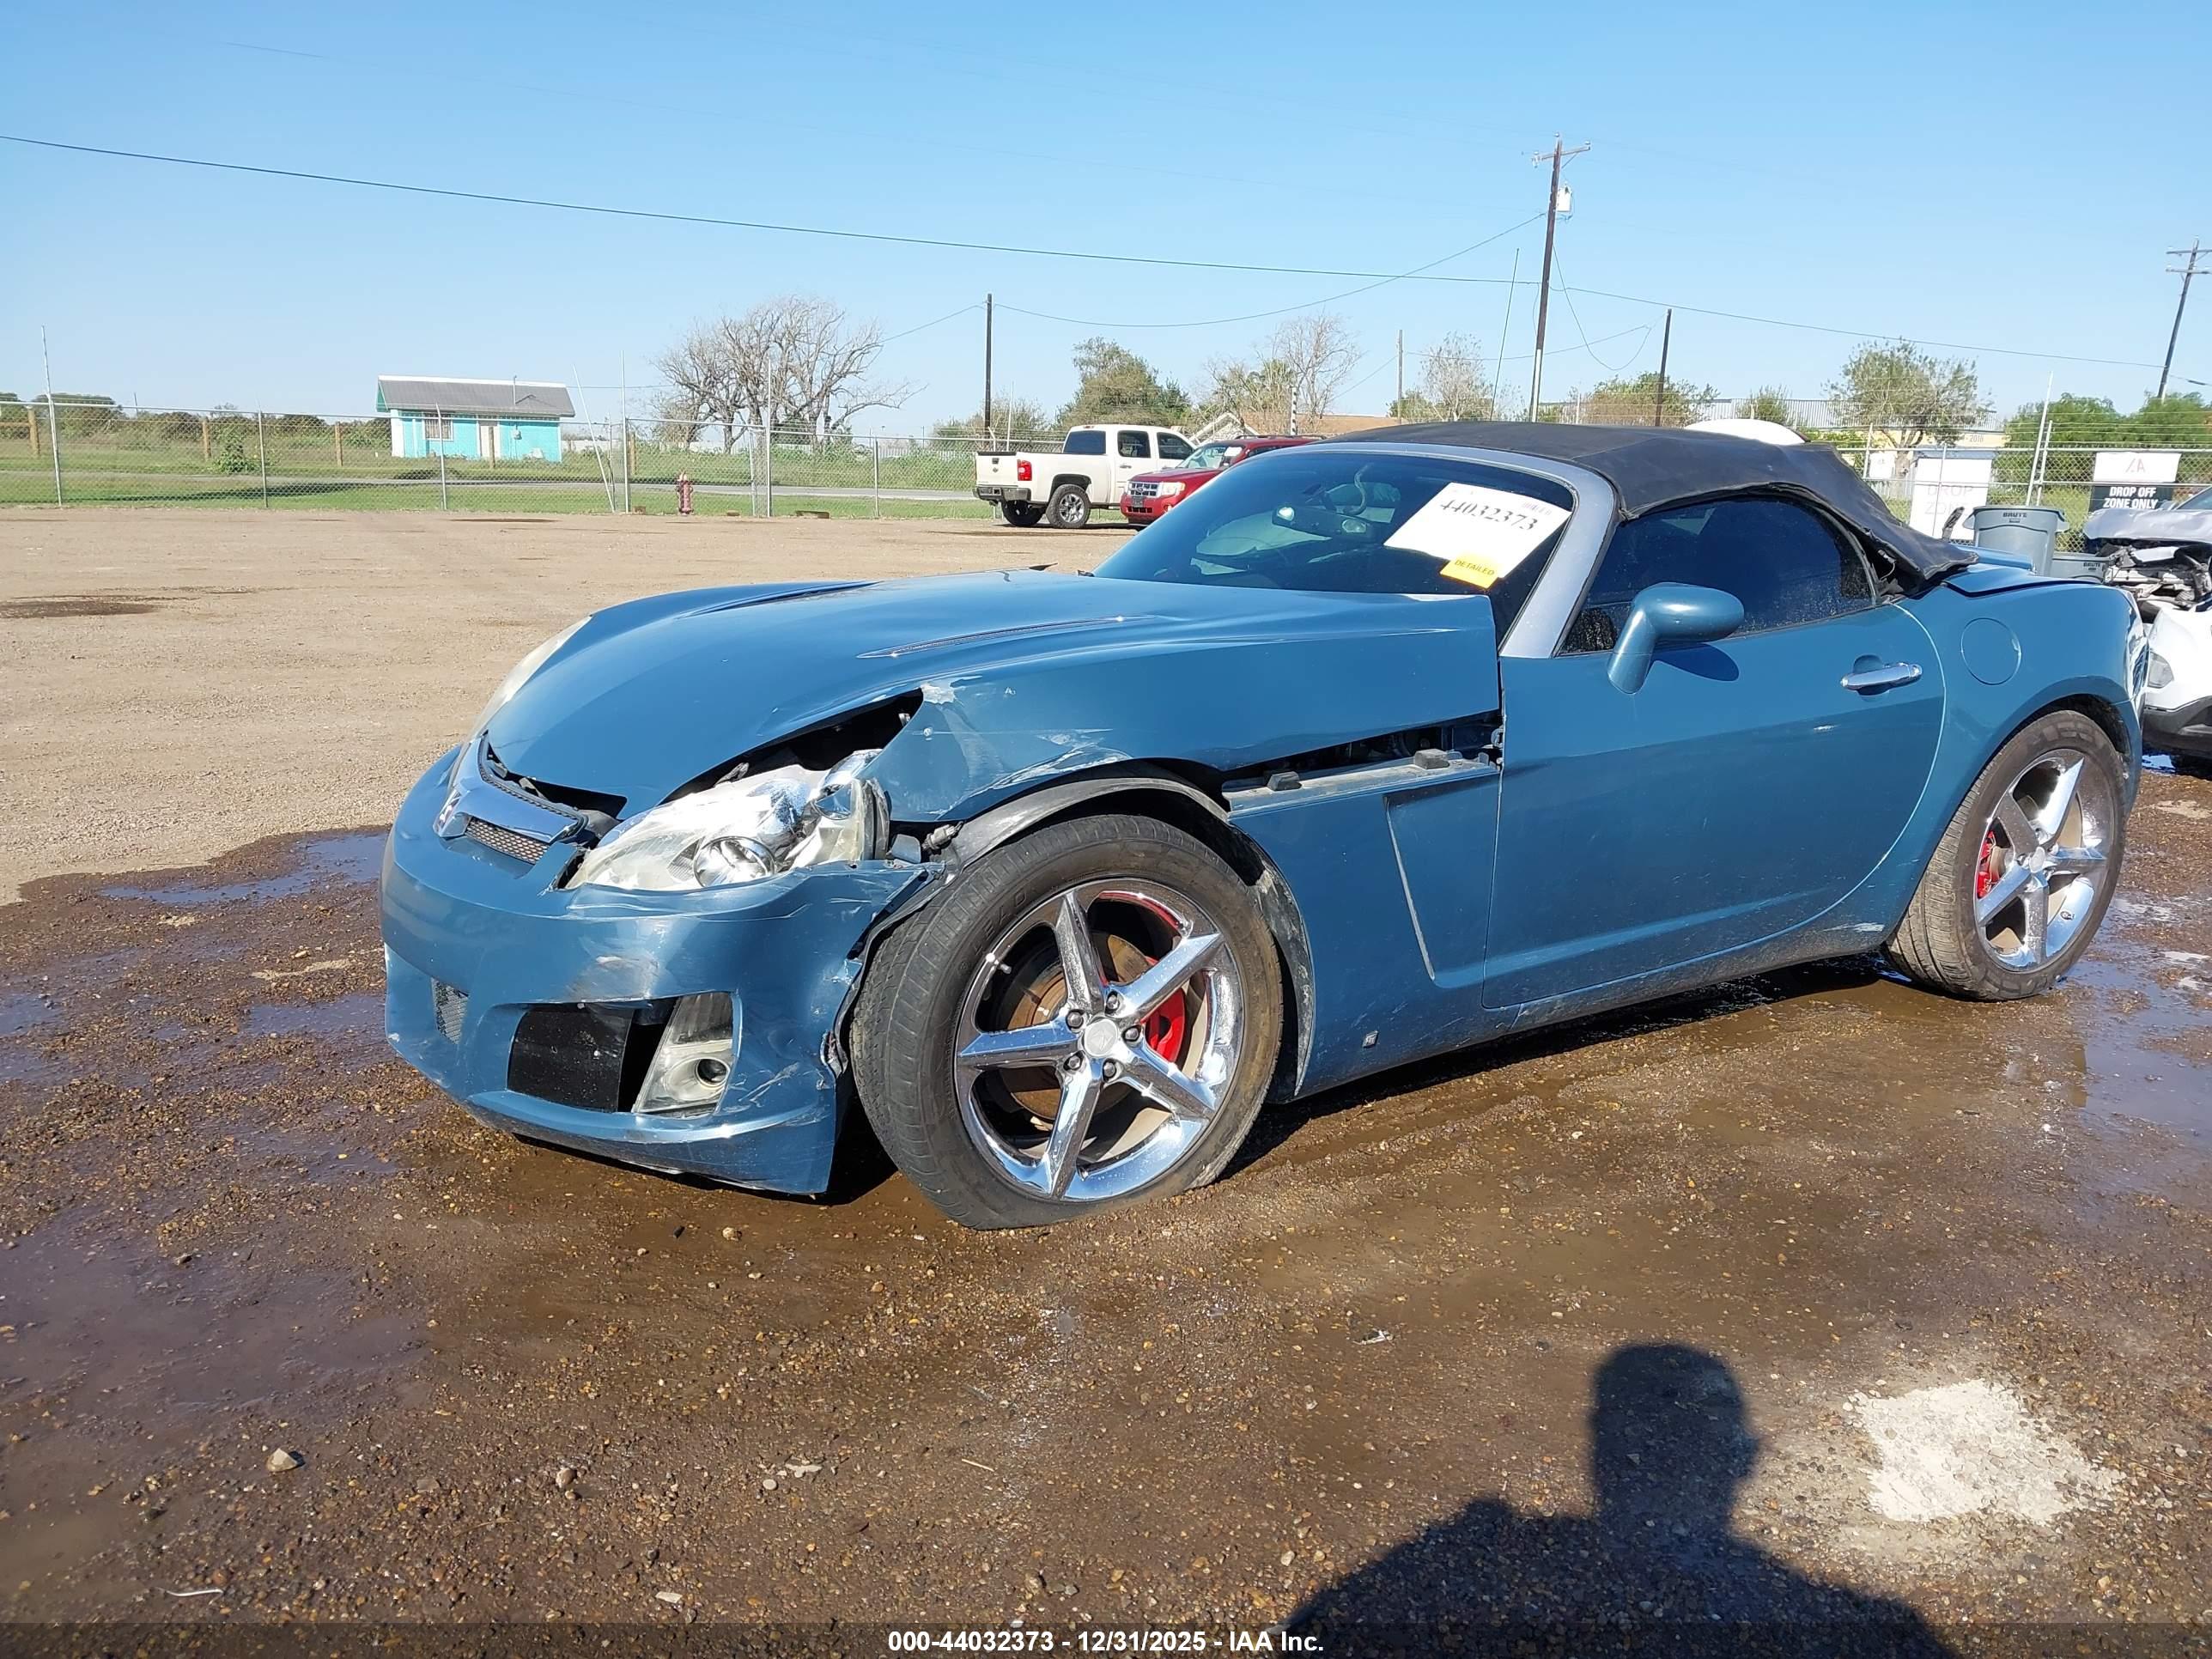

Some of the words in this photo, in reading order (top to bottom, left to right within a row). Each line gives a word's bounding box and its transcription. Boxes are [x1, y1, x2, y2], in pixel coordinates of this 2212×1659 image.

[2109, 486, 2136, 497] DROP
[2137, 487, 2157, 497] OFF
[2103, 498, 2130, 508] ZONE
[2131, 499, 2159, 509] ONLY
[1440, 499, 1538, 531] 44032373
[1454, 559, 1495, 576] DETAILED
